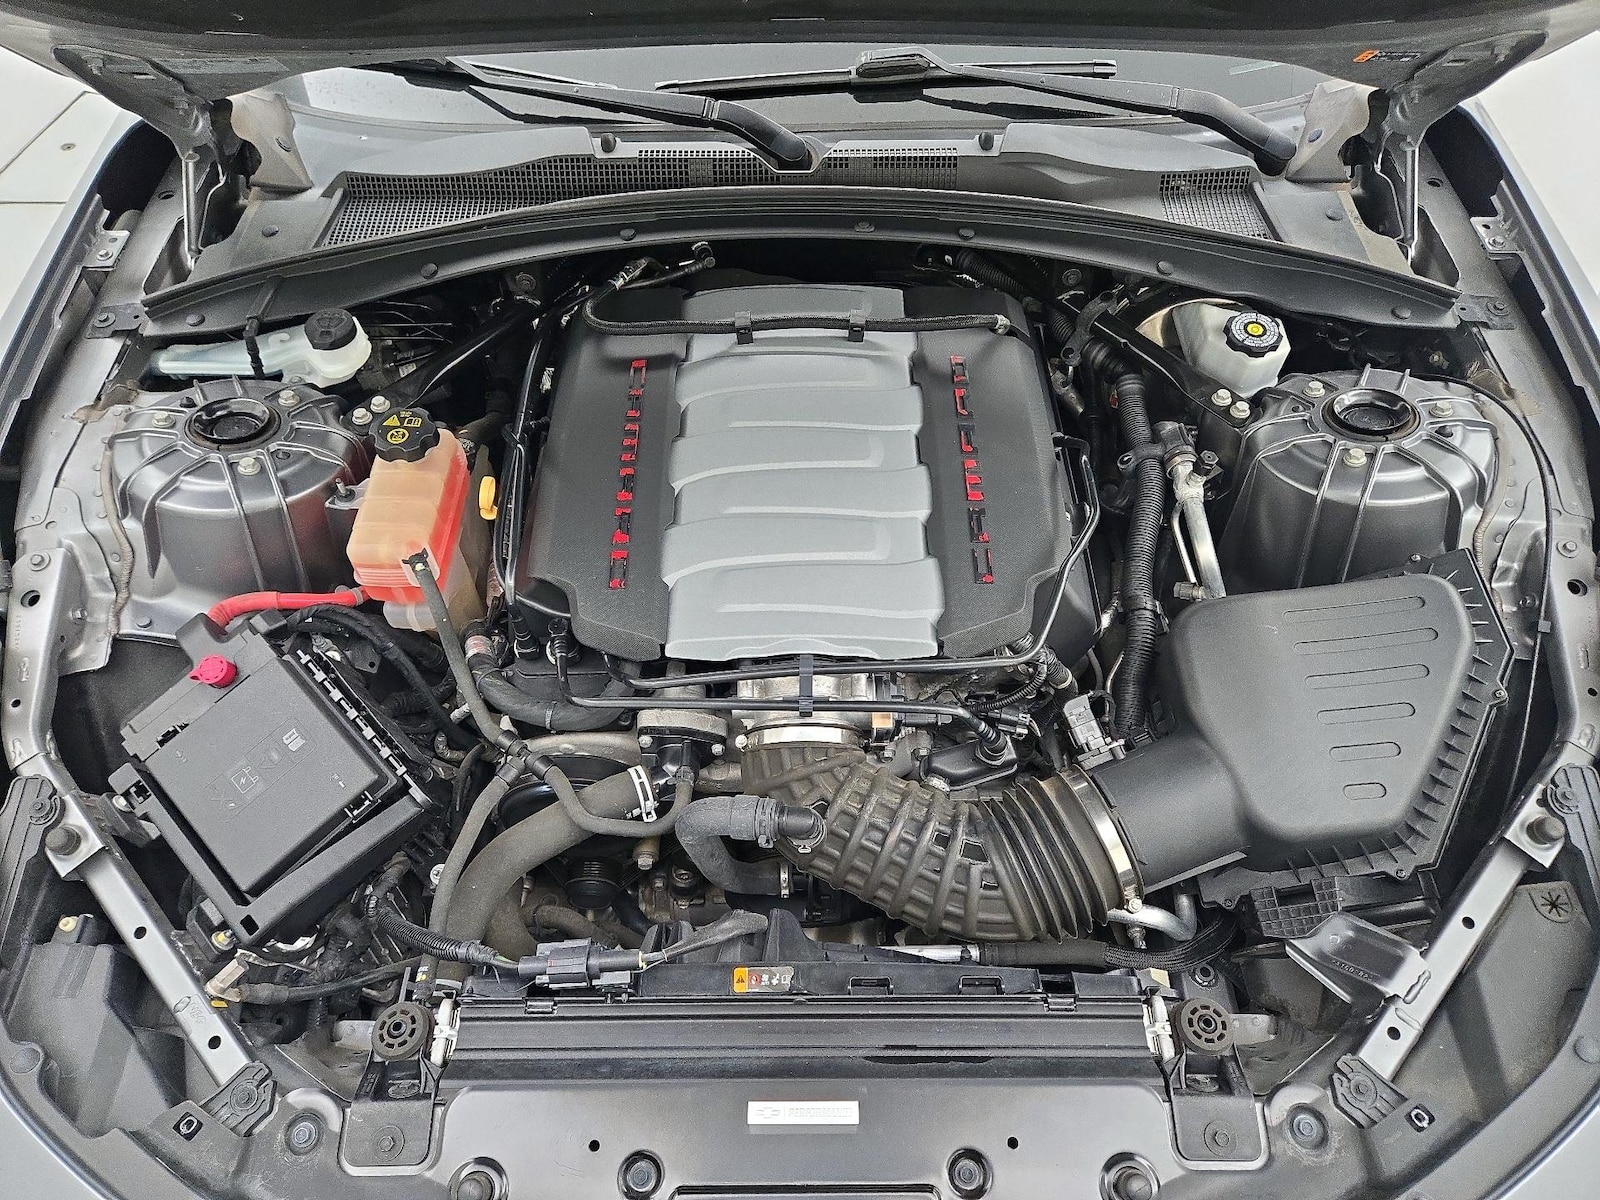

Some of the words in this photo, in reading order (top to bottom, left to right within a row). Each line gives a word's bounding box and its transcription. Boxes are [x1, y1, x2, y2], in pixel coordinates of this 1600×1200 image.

[608, 358, 648, 590] CAMARO
[949, 354, 994, 585] CAMARO
[788, 1107, 854, 1118] PERFORMANCE
